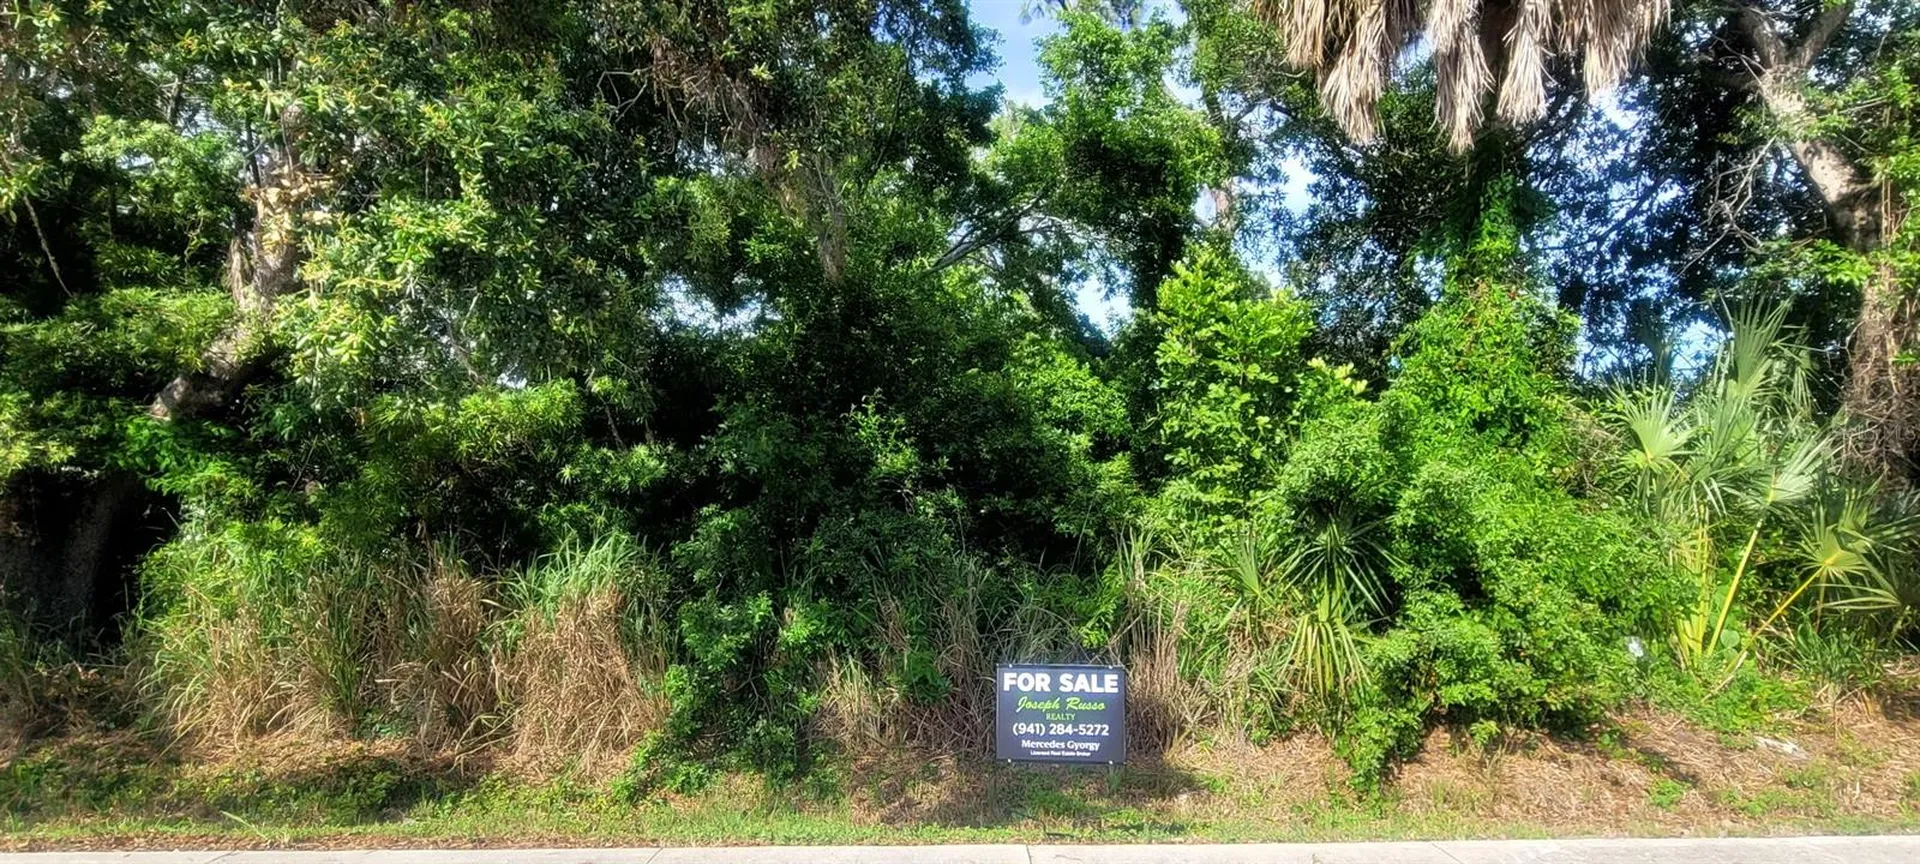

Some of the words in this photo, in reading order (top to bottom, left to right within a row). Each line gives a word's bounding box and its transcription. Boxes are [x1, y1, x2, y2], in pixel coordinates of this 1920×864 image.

[1003, 672, 1051, 692] FOR
[1059, 673, 1119, 693] SALE
[1016, 696, 1060, 713] Joseph
[1066, 697, 1106, 710] Russo
[1046, 713, 1076, 721] REALTY
[1012, 722, 1045, 736] (941)
[1049, 723, 1110, 736] 284-5272
[1021, 740, 1065, 748] Mercedes
[1067, 741, 1100, 751] Gyorgy
